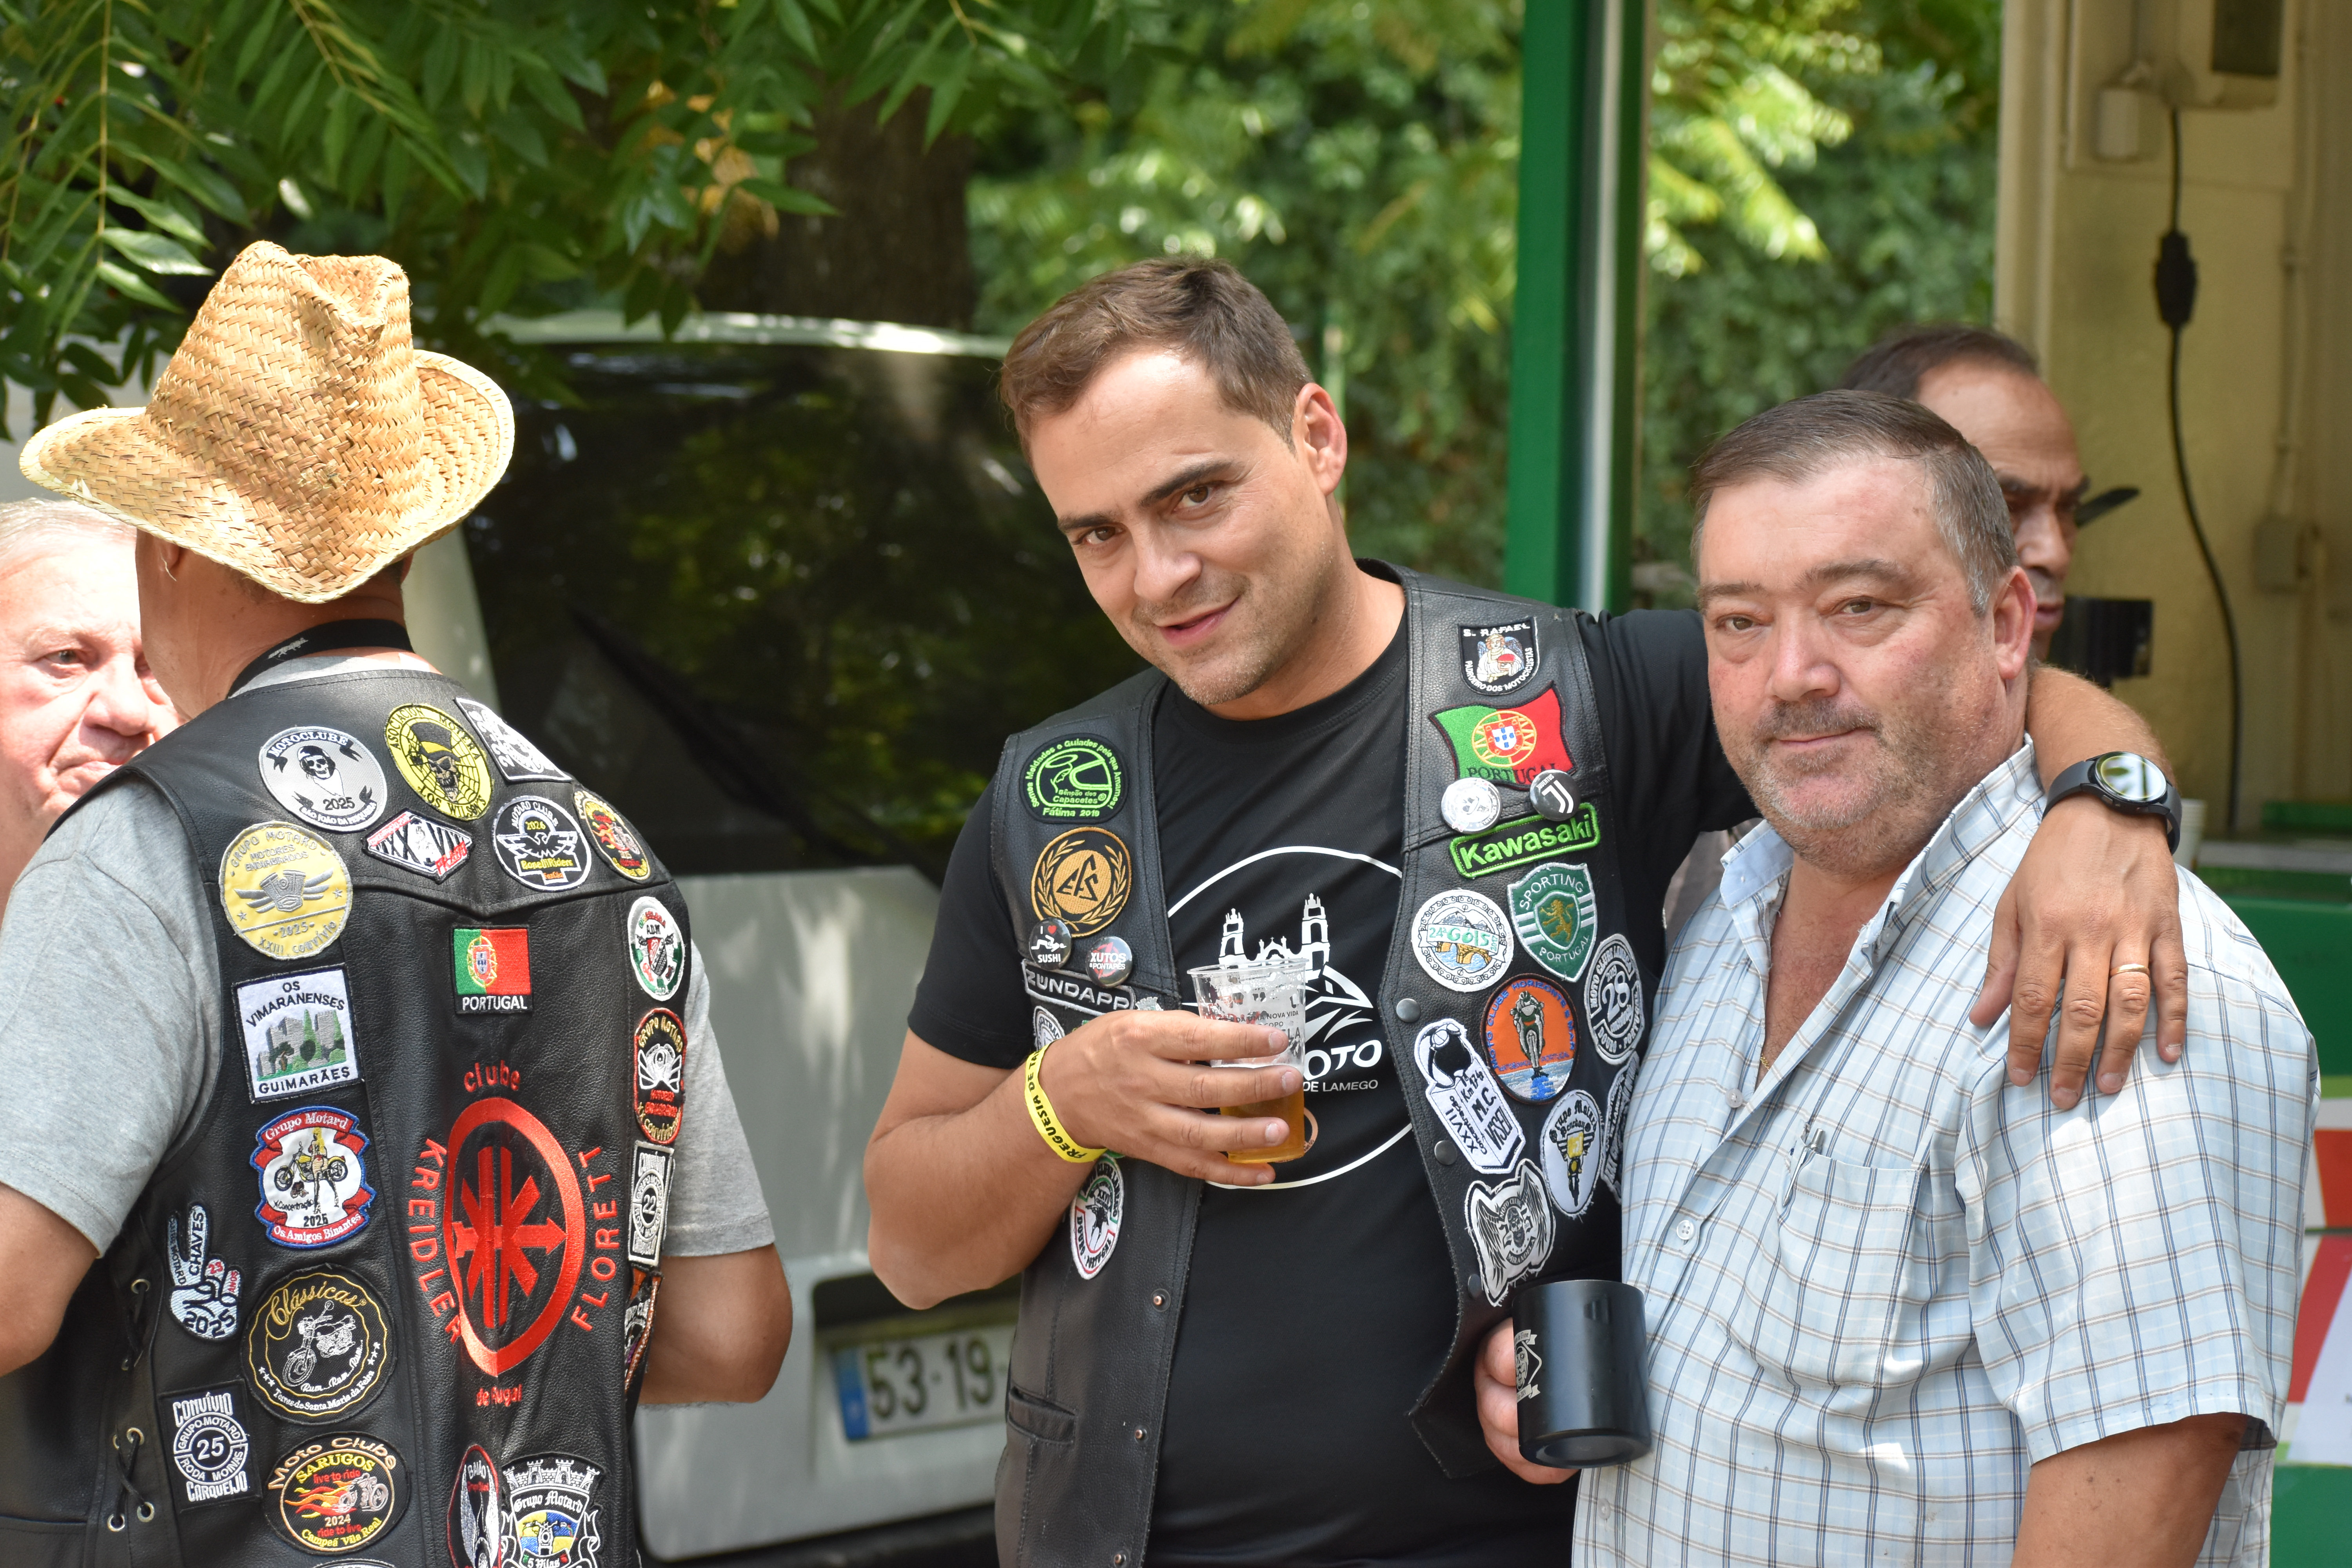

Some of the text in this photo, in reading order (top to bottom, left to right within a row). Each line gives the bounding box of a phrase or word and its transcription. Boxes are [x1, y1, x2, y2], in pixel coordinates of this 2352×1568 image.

[1463, 623, 1530, 637] S. RAFAEL
[1465, 660, 1488, 690] PADROEIRO
[268, 731, 348, 757] MOTOCLUBE
[387, 707, 425, 750] ASOCIACION
[438, 714, 482, 760] MOTERA
[1064, 738, 1098, 748] Guiados
[1025, 747, 1056, 780] Moldados
[1027, 782, 1040, 808] Somos
[1058, 789, 1083, 797] Bênção
[1536, 773, 1555, 790] JUVENTUS
[323, 797, 355, 811] 2025
[418, 785, 442, 808] LOS
[1053, 795, 1098, 804] Capacetes
[1042, 806, 1076, 817] Fátima
[230, 836, 260, 867] GRUPO
[1459, 814, 1593, 869] Kawasaki
[1519, 873, 1584, 910] SPORTING
[1040, 926, 1044, 935] I
[1446, 927, 1491, 946] GÓIS
[1490, 935, 1499, 952] 2017
[1038, 953, 1062, 963] SUSHI
[1090, 952, 1127, 963] XUTOS
[1539, 935, 1590, 963] PORTUGAL
[282, 980, 300, 993] OS
[1511, 979, 1567, 1008] HORIZONTE
[1590, 974, 1600, 1008] MOTO
[1602, 971, 1630, 1022] 28
[246, 992, 345, 1027] VIMARANENSES
[462, 995, 528, 1011] PORTUGAL
[1266, 1011, 1286, 1020] NOVA
[1487, 990, 1509, 1027] CLUBE
[1567, 1020, 1575, 1051] MAR
[1303, 1039, 1382, 1081] OTO
[1486, 1031, 1499, 1070] MOTO
[259, 1066, 350, 1094] GUIMARÃES
[463, 1060, 521, 1093] clube
[1027, 1072, 1036, 1092] DE
[1323, 1079, 1379, 1092] LAMEGO
[265, 1111, 349, 1140] Grupo Motard
[1032, 1094, 1088, 1159] FREGUESIA
[1445, 1108, 1479, 1154] XXVII
[1484, 1106, 1513, 1151] VISEU
[642, 1194, 656, 1215] 22
[1499, 1200, 1509, 1220] MOTO
[274, 1213, 361, 1243] Os Amigos Binantes
[408, 1138, 461, 1345] KREIDLER
[571, 1147, 620, 1332] FLORETT
[1077, 1216, 1085, 1256] DOURO
[188, 1211, 204, 1276] CHAVES
[208, 1261, 224, 1275] 23
[172, 1392, 234, 1428] CONVÍVIO
[476, 1388, 490, 1406] de
[178, 1416, 241, 1450] GRUPO MOTARD
[197, 1436, 224, 1460] 25
[180, 1451, 244, 1481] RODA MOINAS
[268, 1437, 397, 1490] Moto Clube
[295, 1453, 376, 1484] SARUGOS
[313, 1469, 362, 1484] live to ride
[513, 1490, 584, 1513] Grupo Motard
[301, 1517, 383, 1548] Campeã Vila Real
[317, 1528, 334, 1538] ride
[336, 1526, 346, 1535] to
[324, 1514, 351, 1527] 2024
